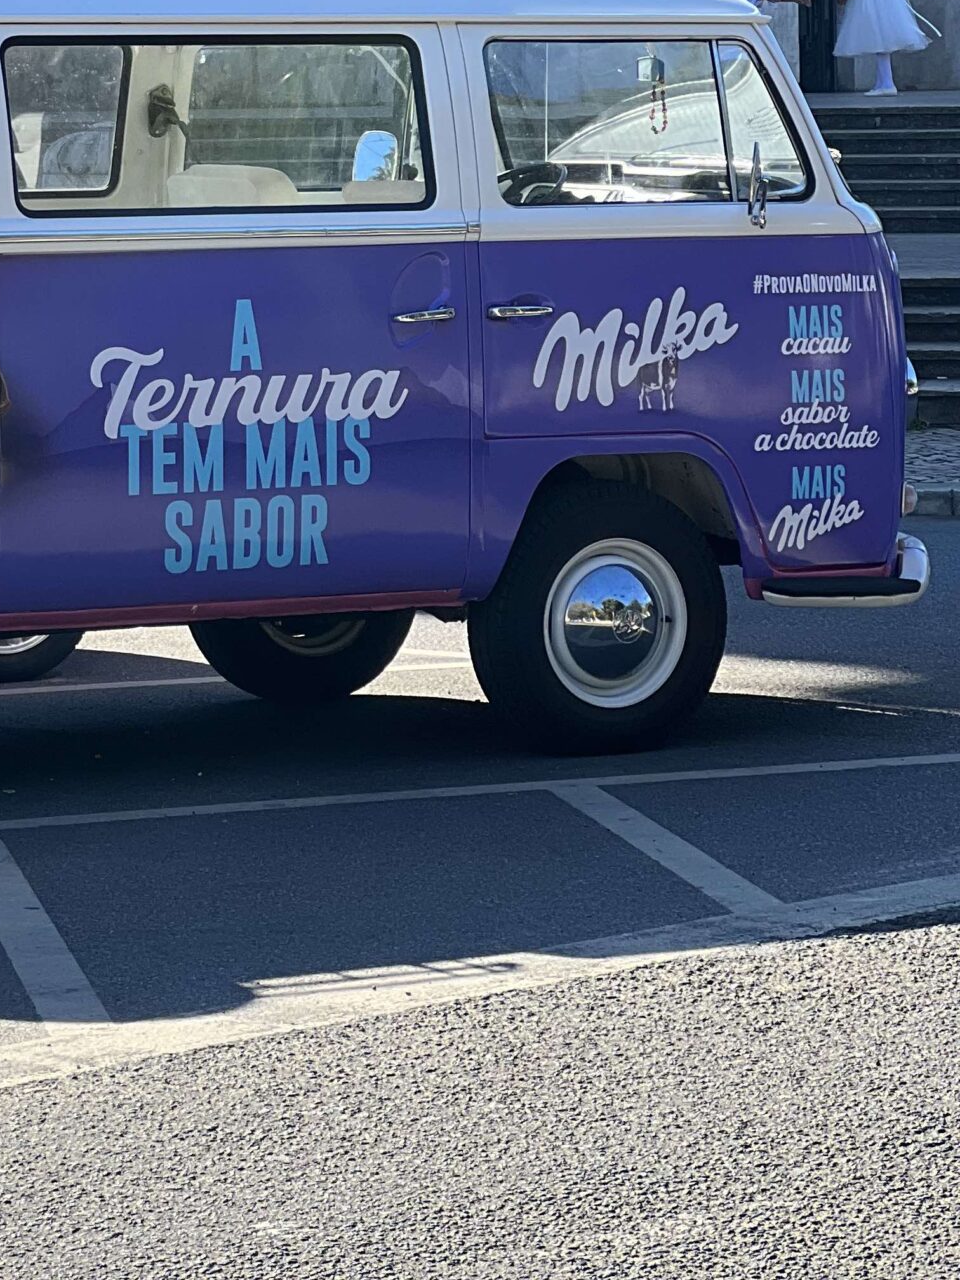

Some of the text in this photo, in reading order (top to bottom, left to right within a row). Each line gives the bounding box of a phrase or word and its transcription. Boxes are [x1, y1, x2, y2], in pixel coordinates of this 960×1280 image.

[229, 298, 263, 371] A
[781, 336, 851, 355] cacau
[788, 304, 843, 339] MAIS
[532, 286, 739, 412] Milka
[90, 346, 409, 440] Ternura
[791, 368, 845, 403] MAIS
[780, 398, 850, 425] sabor
[120, 415, 372, 496] TEM MAIS
[754, 423, 880, 452] a chocolate
[791, 464, 845, 500] MAIS
[164, 494, 329, 574] SABOR
[768, 492, 864, 553] Milka
